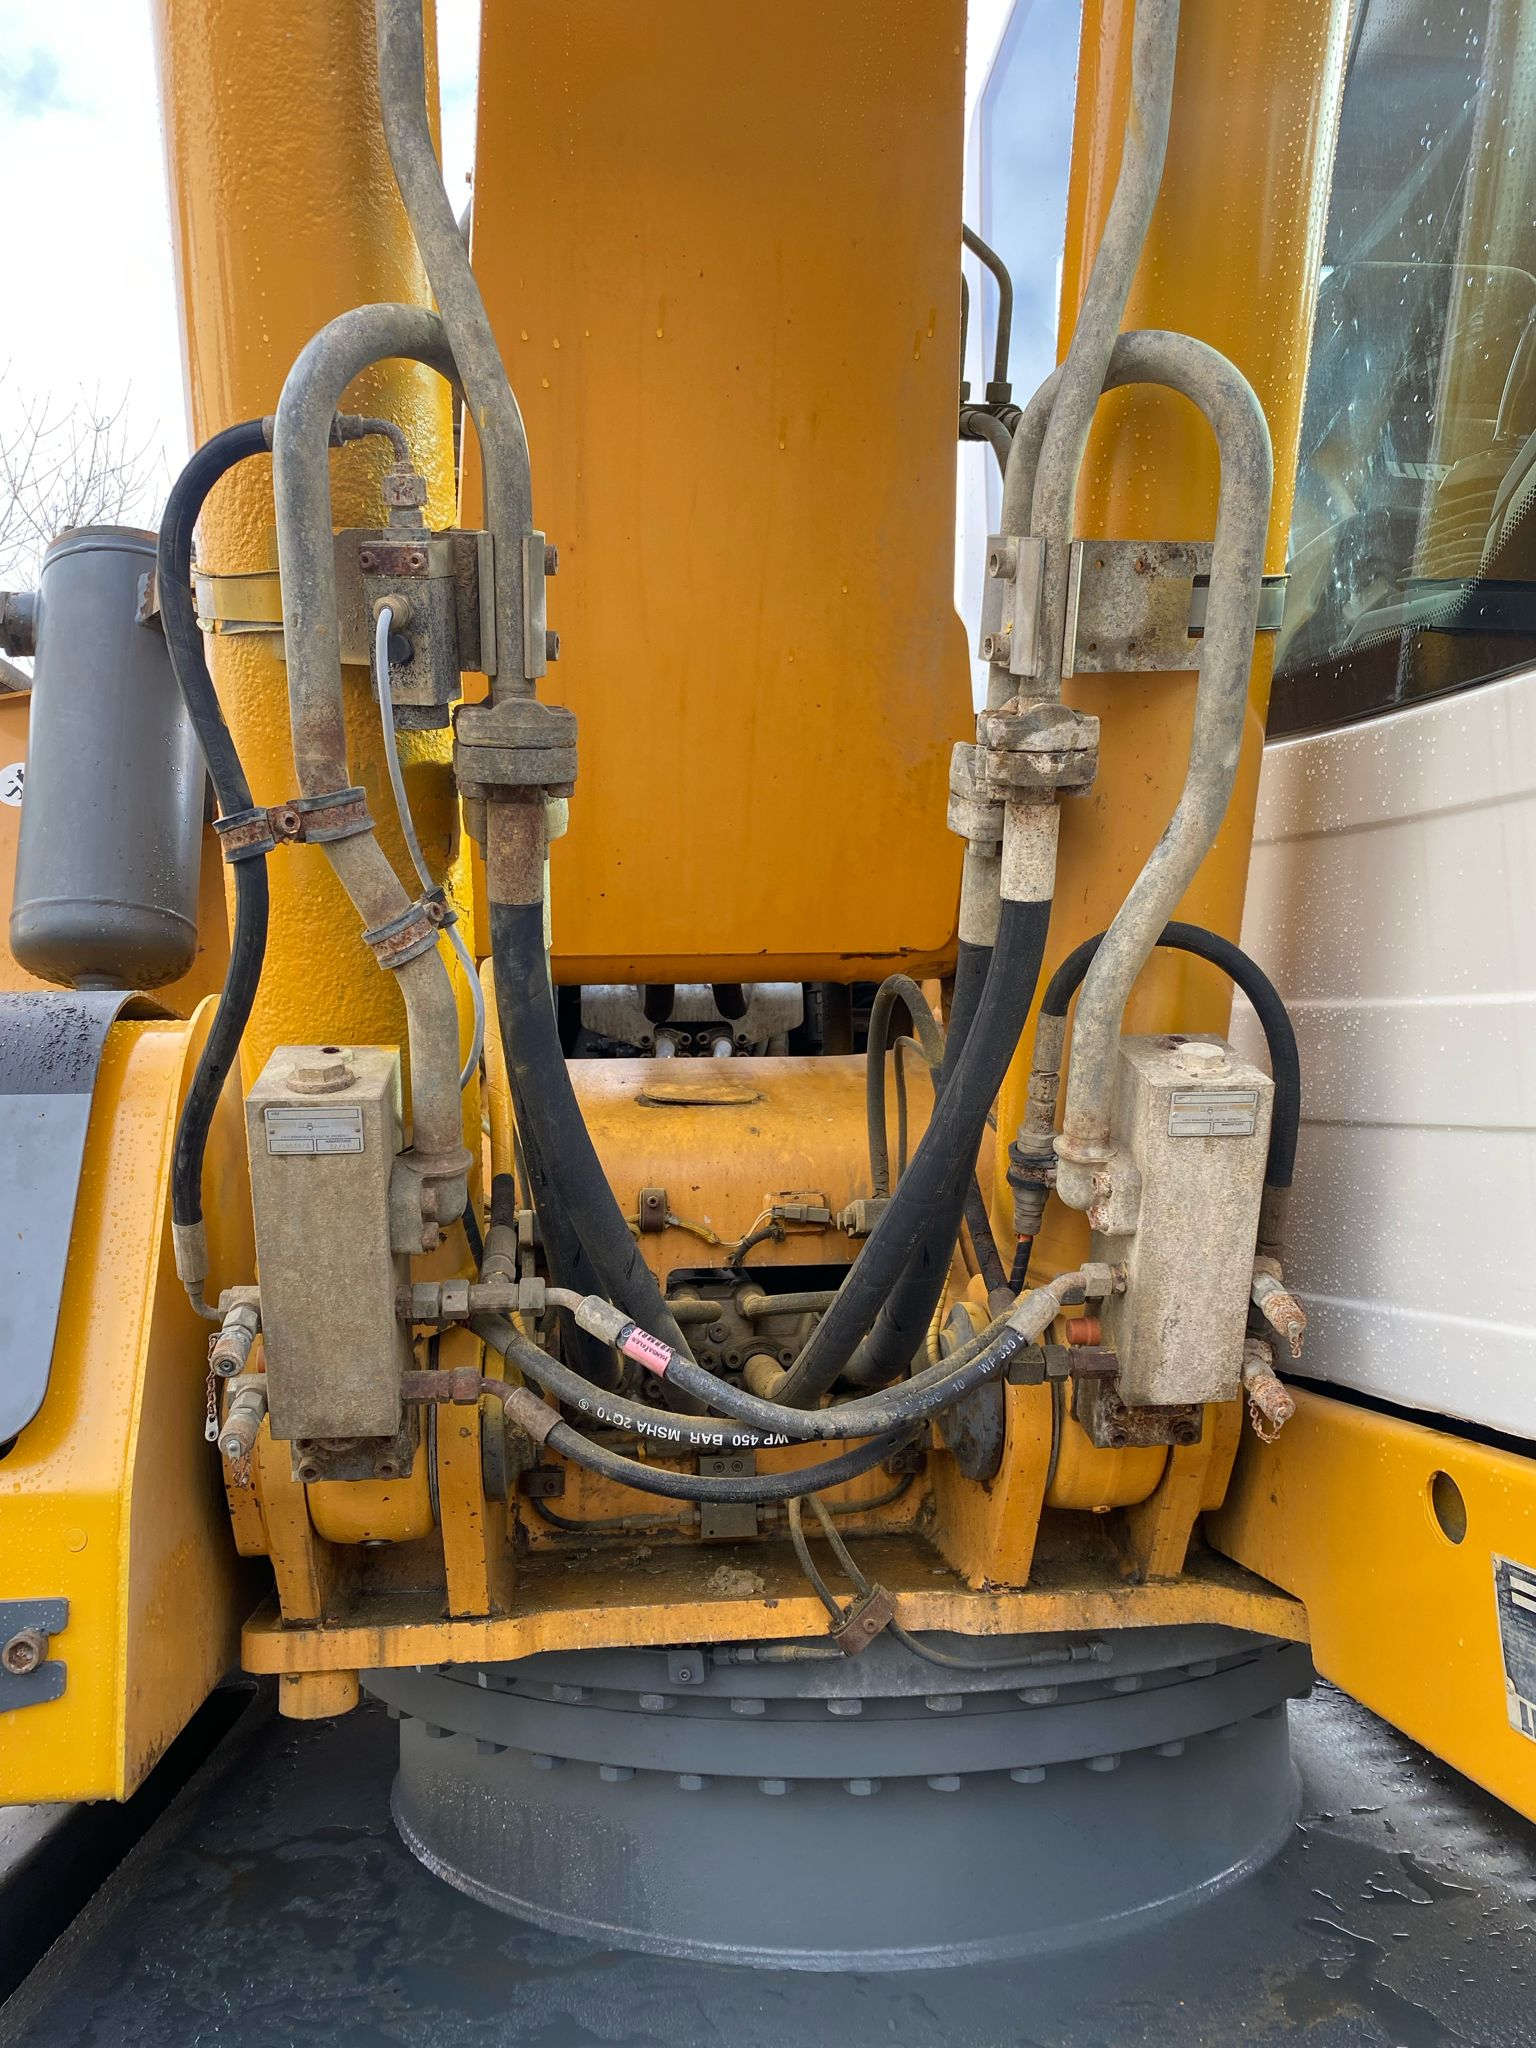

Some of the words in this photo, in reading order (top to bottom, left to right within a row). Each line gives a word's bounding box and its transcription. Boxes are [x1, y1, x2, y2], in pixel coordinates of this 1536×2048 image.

[952, 1379, 966, 1392] 10
[978, 1357, 996, 1374] WP
[1000, 1339, 1017, 1359] 330
[636, 1421, 680, 1441] MSHA
[690, 1432, 723, 1446] BAR
[732, 1434, 759, 1446] 450
[763, 1433, 789, 1445] WP
